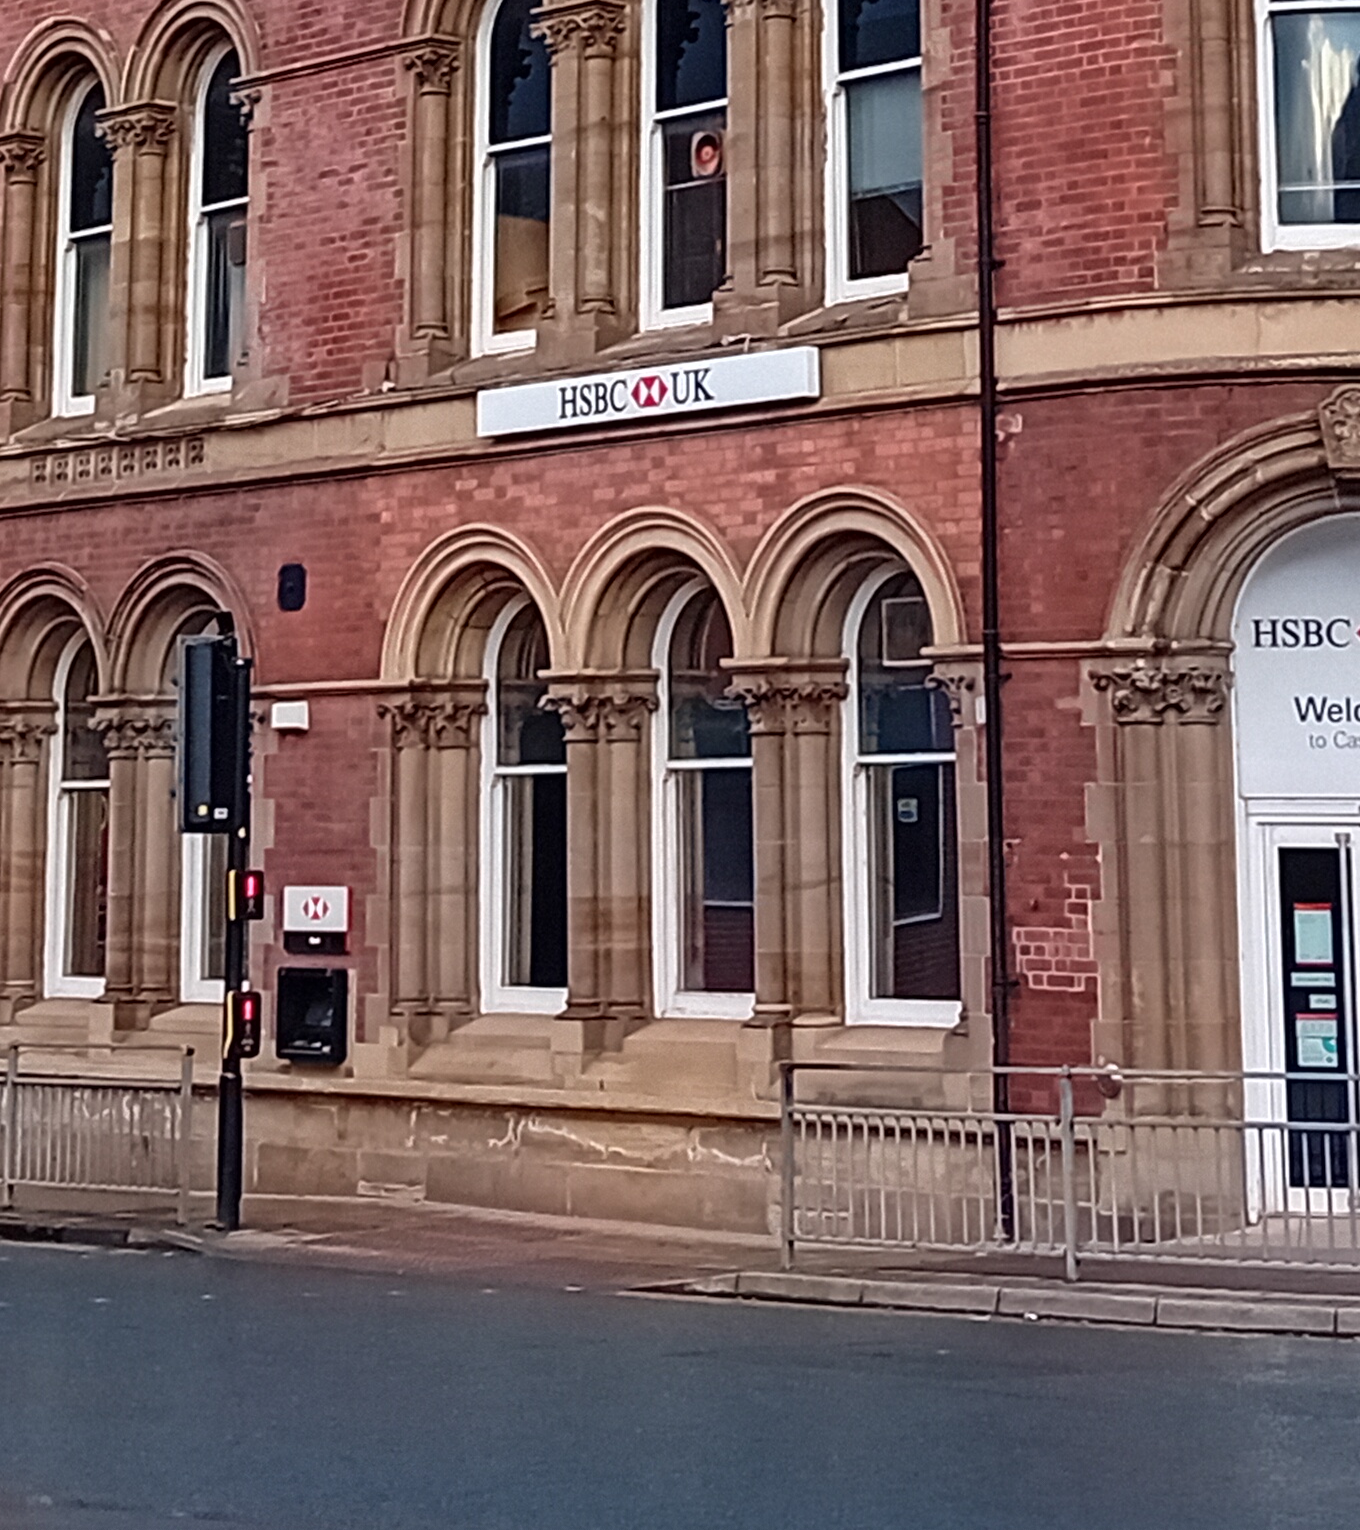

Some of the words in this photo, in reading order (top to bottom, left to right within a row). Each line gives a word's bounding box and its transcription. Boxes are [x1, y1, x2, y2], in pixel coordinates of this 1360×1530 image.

[559, 379, 628, 419] HSBC
[670, 368, 715, 405] UK
[1252, 618, 1351, 648] HSBC
[1309, 733, 1327, 749] to
